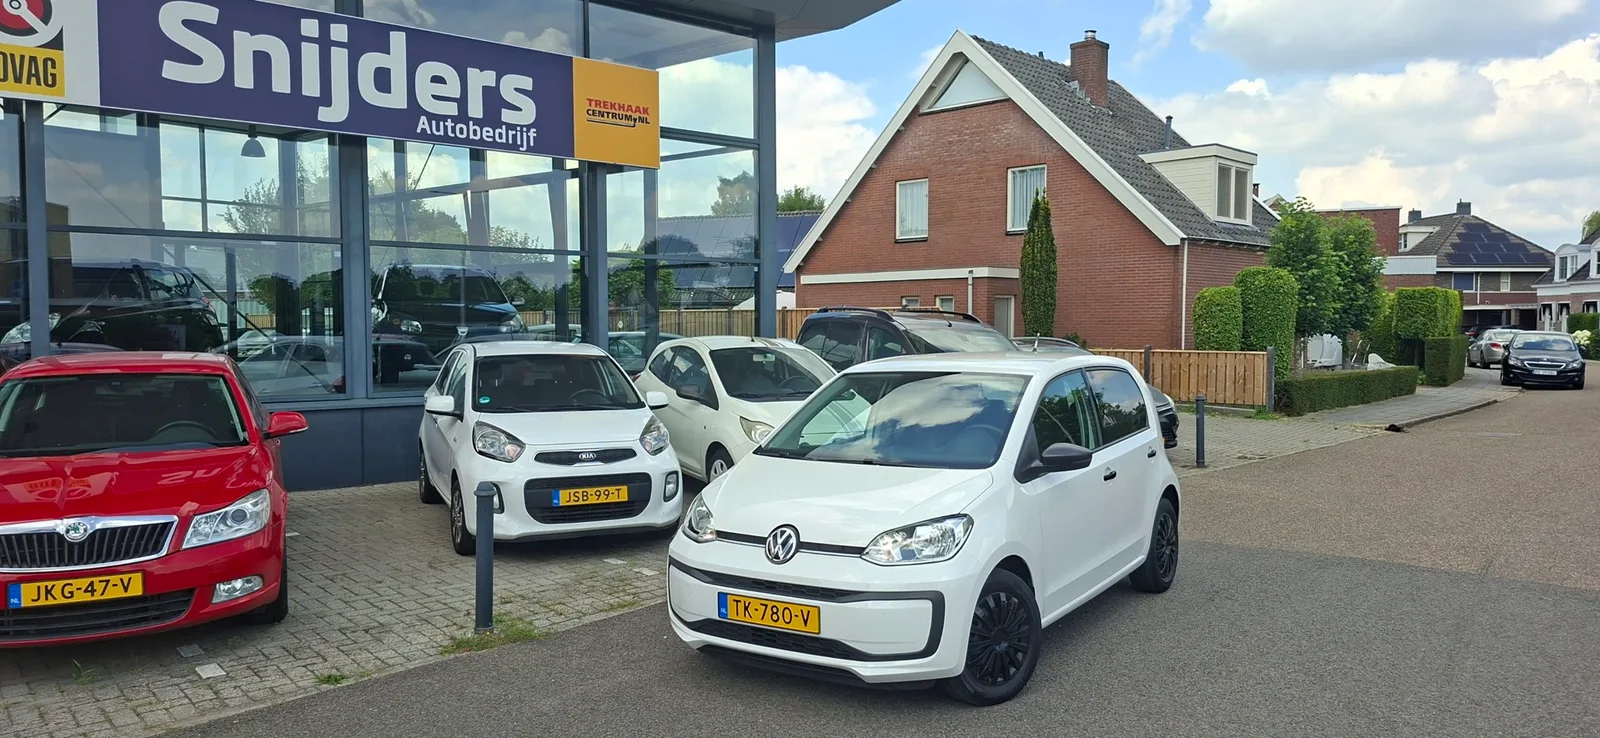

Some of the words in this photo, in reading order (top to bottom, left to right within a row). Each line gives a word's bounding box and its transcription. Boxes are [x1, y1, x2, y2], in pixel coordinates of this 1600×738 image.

[158, 0, 537, 125] Snijders
[586, 98, 650, 115] TREKHAAK
[416, 115, 537, 151] Autobedrijf
[565, 488, 622, 503] JSB-99-T
[31, 577, 132, 602] JKG-47-V
[733, 599, 811, 627] TK-780-V
